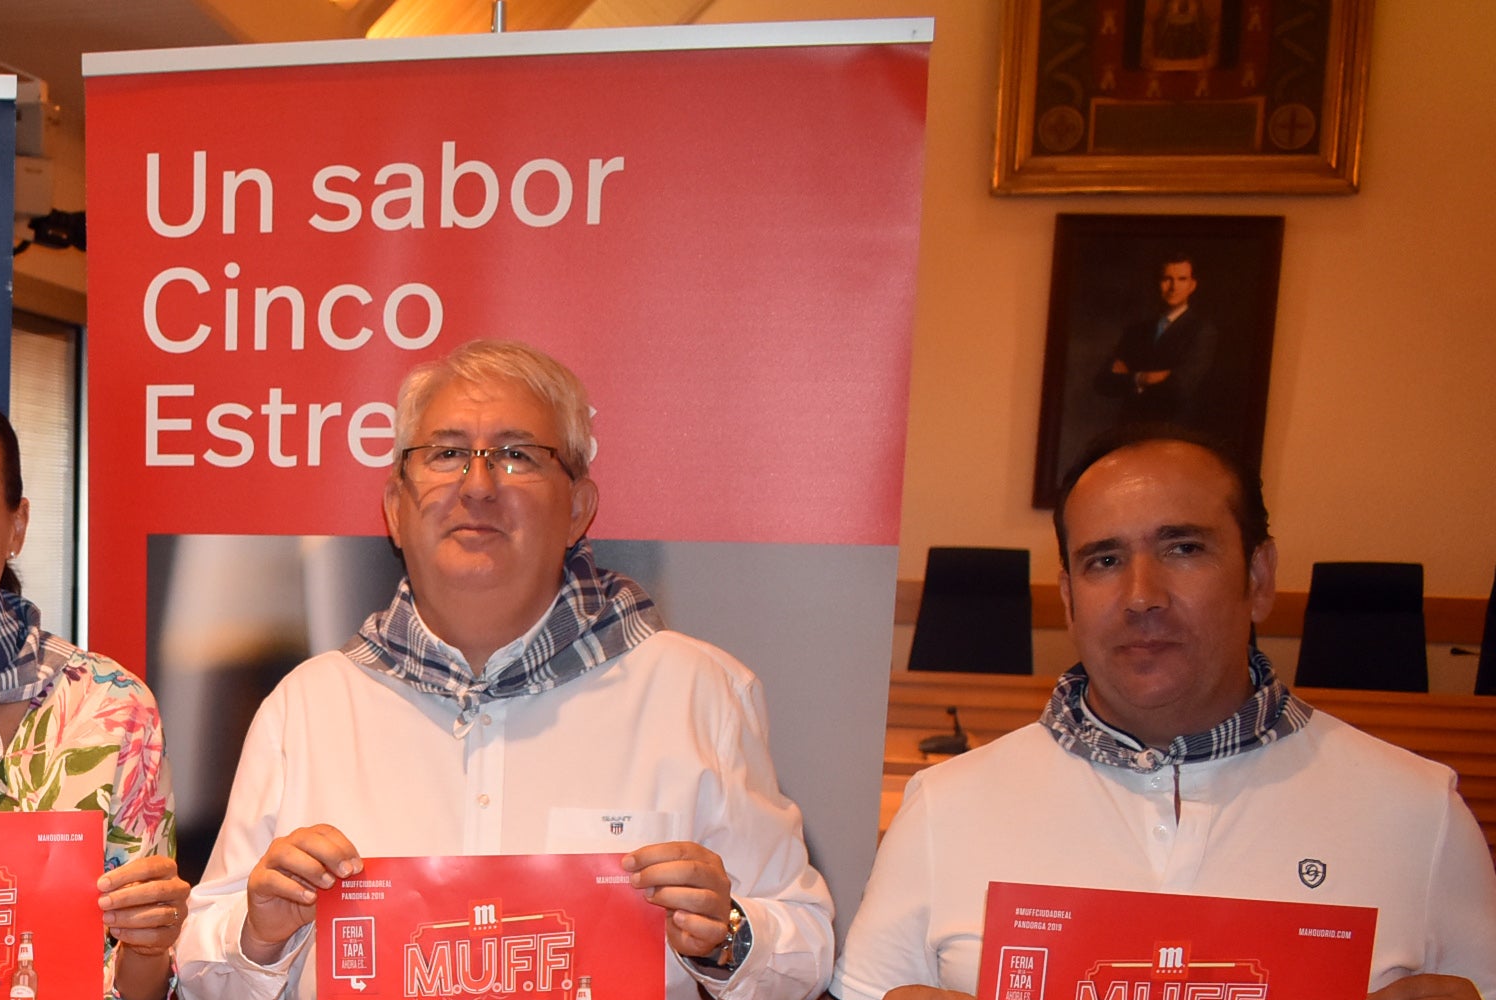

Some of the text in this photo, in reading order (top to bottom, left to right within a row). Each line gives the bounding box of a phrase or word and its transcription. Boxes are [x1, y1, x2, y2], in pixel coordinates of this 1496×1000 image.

[146, 141, 624, 238] Un sabor
[143, 262, 443, 353] Cinco
[343, 926, 363, 940] FERIA
[1048, 923, 1062, 931] 2019
[343, 944, 363, 956] TAPA
[404, 931, 574, 997] M.U.F.F.
[1011, 956, 1033, 969] FERIA
[1010, 972, 1031, 989] TAPA
